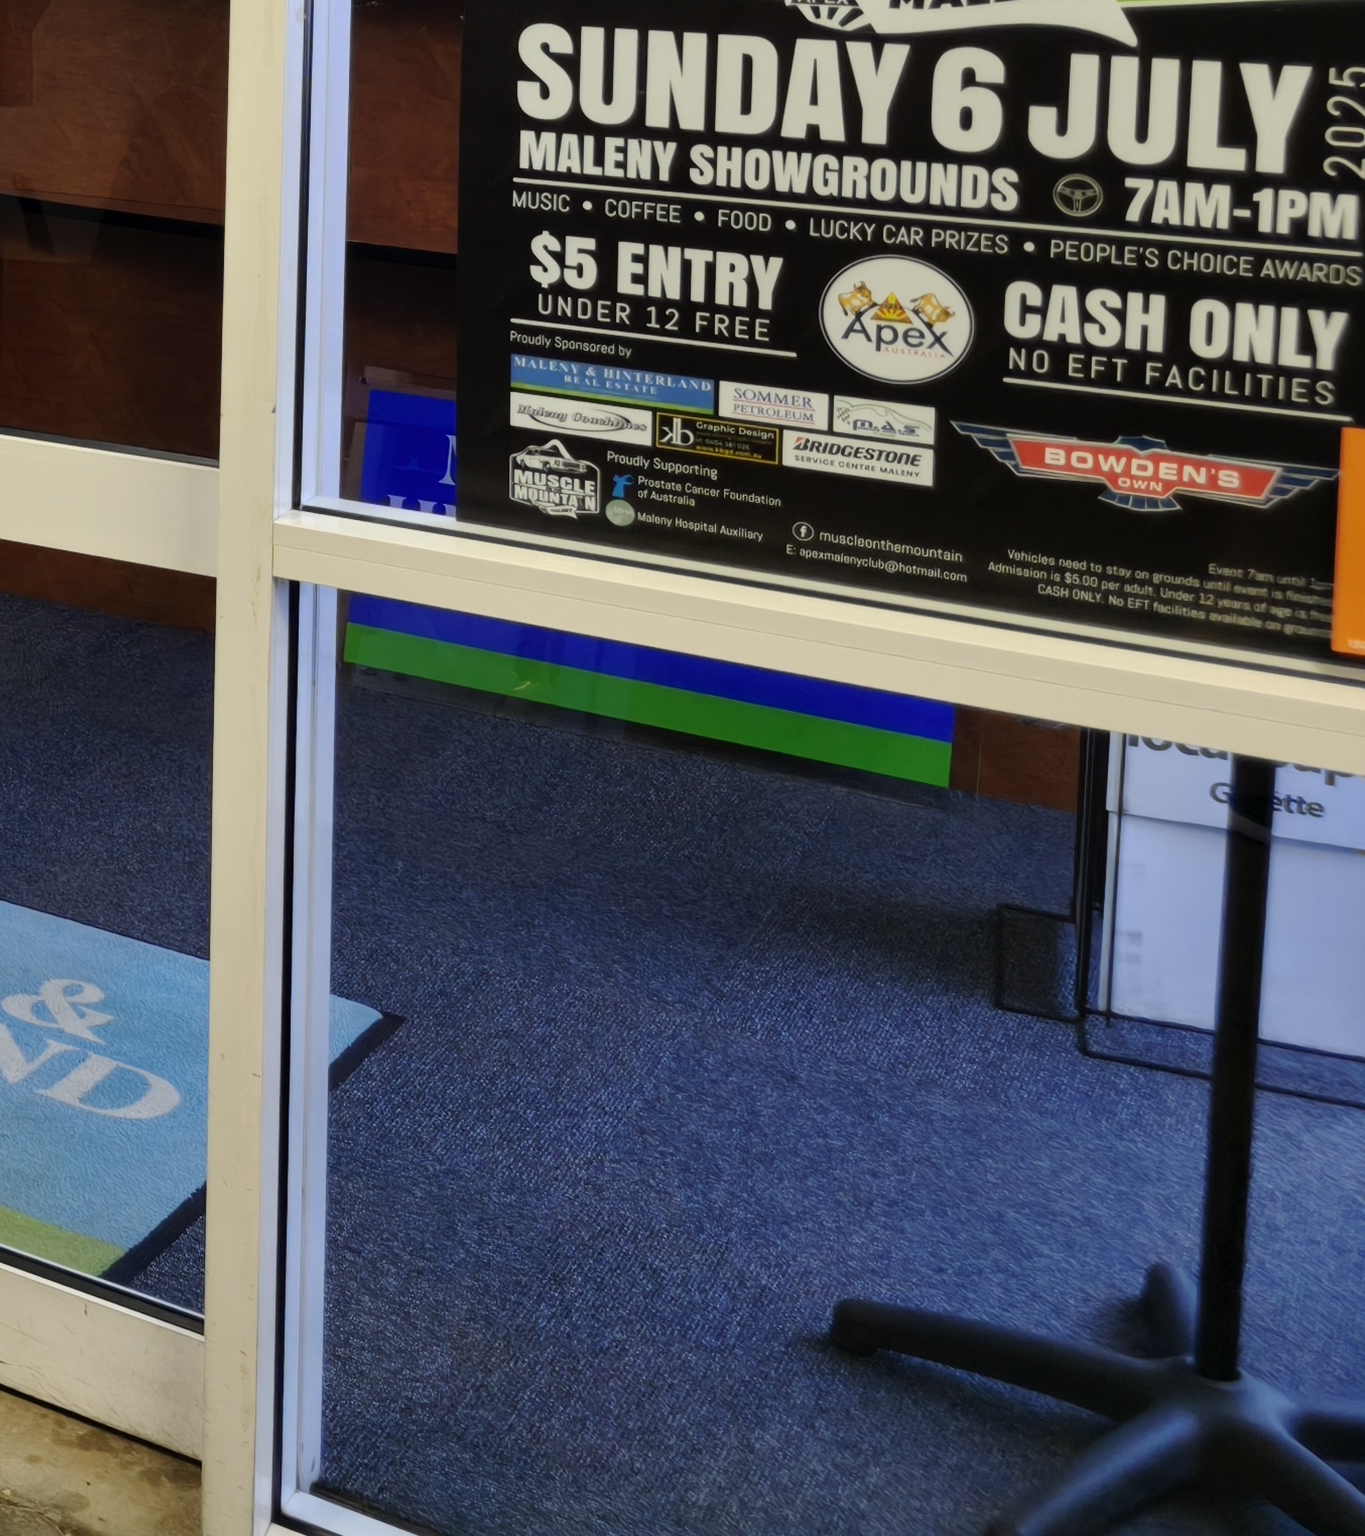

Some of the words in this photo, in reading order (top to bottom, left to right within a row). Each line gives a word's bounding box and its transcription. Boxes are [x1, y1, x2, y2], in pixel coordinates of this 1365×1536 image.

[516, 22, 911, 145] SUNDAY
[931, 46, 1006, 153] 6
[1028, 53, 1313, 174] JULY
[1323, 66, 1365, 180] 2025
[519, 130, 677, 182] MALENY
[689, 143, 1020, 212] SHOWGROUNDS
[1125, 177, 1359, 241] 7AM-1PM
[512, 190, 570, 213] MUSIC
[604, 199, 681, 224] COFFEE
[718, 210, 771, 232] FOOD
[810, 217, 875, 243] LUCKY
[882, 224, 924, 247] CAR
[932, 229, 1009, 255] PRIZES
[1051, 239, 1159, 268] PEOPLE'S
[1167, 249, 1253, 278] CHOICE
[1260, 258, 1364, 287] AWARDS
[529, 230, 597, 290] $5
[617, 241, 784, 311] ENTRY
[538, 293, 630, 325] UNDER
[645, 306, 680, 331] 12
[695, 311, 770, 341] FREE
[1003, 279, 1165, 353] CASH
[1189, 298, 1350, 372] ONLY
[509, 331, 552, 349] Proudly
[554, 336, 615, 355] Sponsored
[618, 344, 632, 359] by
[841, 309, 956, 357] Apex
[883, 346, 947, 359] AUSTRALIA
[513, 356, 579, 374] MALENY
[585, 366, 597, 377] &
[604, 368, 712, 392] HINTERLAND
[564, 375, 600, 386] REAL
[606, 380, 658, 395] ESTATE
[1008, 347, 1050, 373] NO
[1068, 354, 1128, 383] EFT
[1145, 362, 1336, 406] FACILITIES
[733, 404, 814, 422] PETROLEUM
[734, 388, 813, 409] SOMMER
[696, 421, 736, 434] Graphic
[739, 427, 775, 440] Design
[606, 451, 650, 470] Proudly
[653, 457, 718, 480] Supporting
[793, 437, 922, 467] BRIDGESTONE
[794, 455, 836, 467] SERVICE
[839, 461, 876, 474] CENTRE
[880, 467, 921, 479] MALENY
[514, 469, 596, 495] MUSCLE
[1044, 447, 1240, 489] BOWDEN'S
[514, 485, 596, 511] MOUNTAN
[637, 488, 648, 499] of
[650, 490, 696, 507] Australia
[638, 475, 682, 492] Prostate
[684, 482, 720, 497] Cancer
[723, 488, 781, 507] Foundation
[1118, 477, 1162, 492] OWN
[637, 511, 673, 527] Maleny
[675, 516, 717, 534] Hospital
[719, 523, 764, 542] Auxiliary
[819, 531, 963, 562] muscleonthemountain
[786, 544, 796, 555] E:
[799, 548, 967, 583] apexmalenyclub@hotmail.com
[988, 561, 1047, 579] Admission
[1050, 570, 1060, 582] is
[1101, 579, 1120, 591] per
[1008, 549, 1055, 566] Vehicles
[1059, 557, 1086, 570] need
[1090, 562, 1102, 573] to
[1106, 565, 1131, 579] stay
[1038, 584, 1069, 598] CASH
[1108, 595, 1124, 607] No
[1127, 598, 1149, 610] EFT
[0, 977, 117, 1045] &
